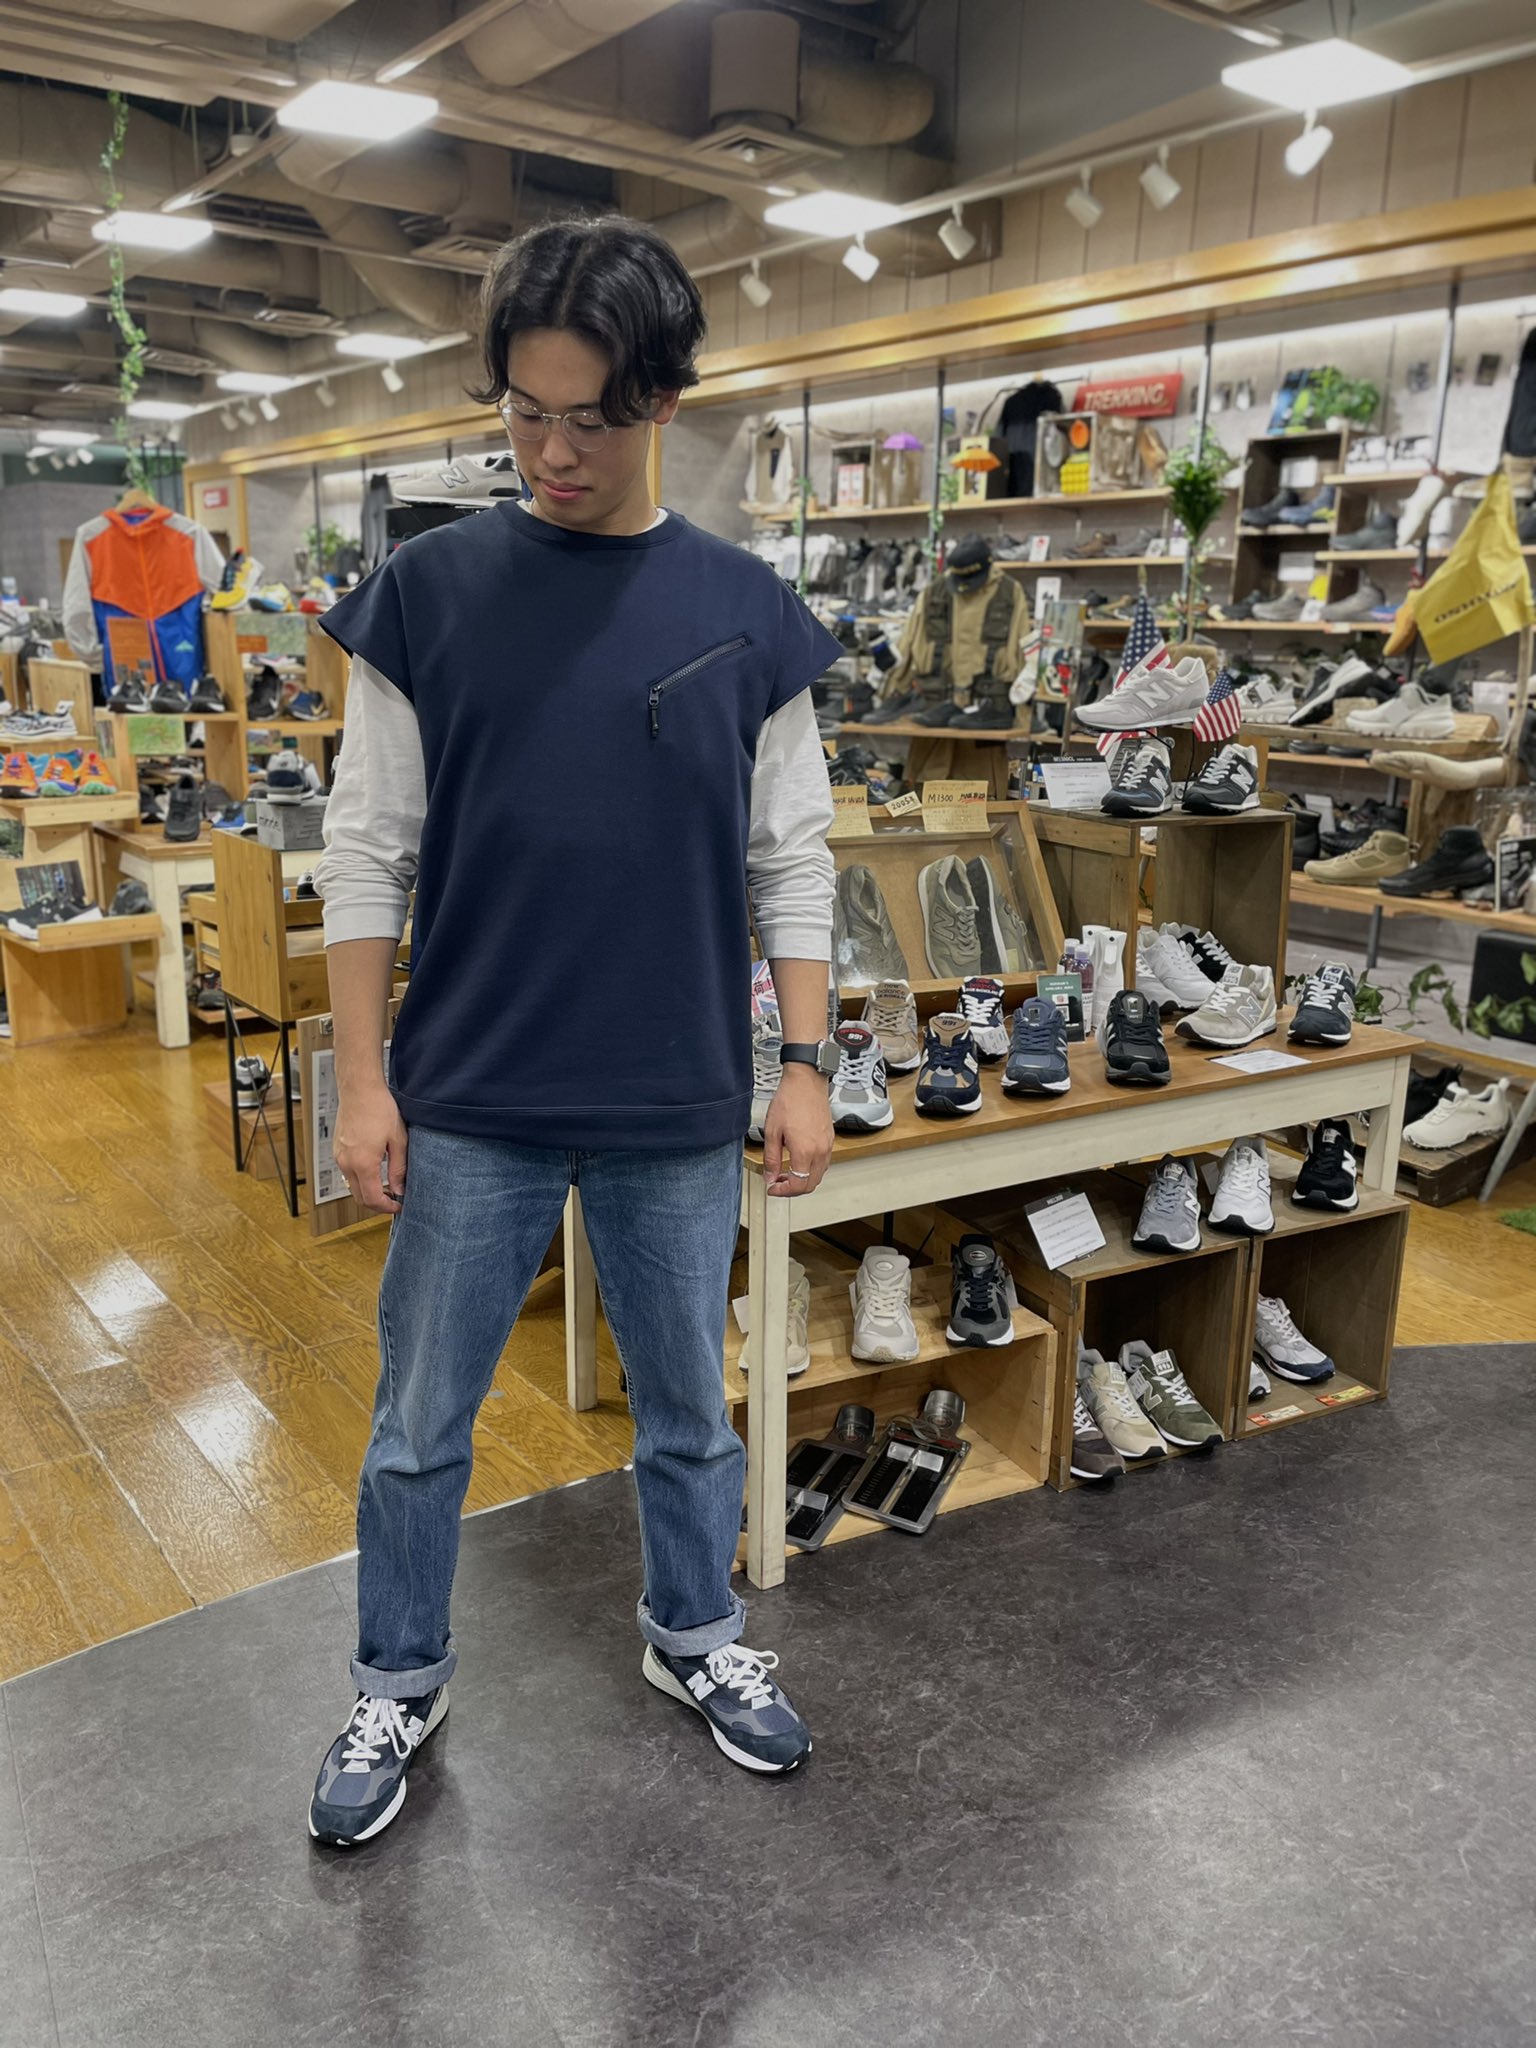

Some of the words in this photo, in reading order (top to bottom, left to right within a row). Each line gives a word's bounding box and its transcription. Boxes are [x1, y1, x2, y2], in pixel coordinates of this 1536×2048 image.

[1083, 383, 1165, 410] TREKKING
[847, 1032, 863, 1041] 991
[685, 1669, 717, 1701] N
